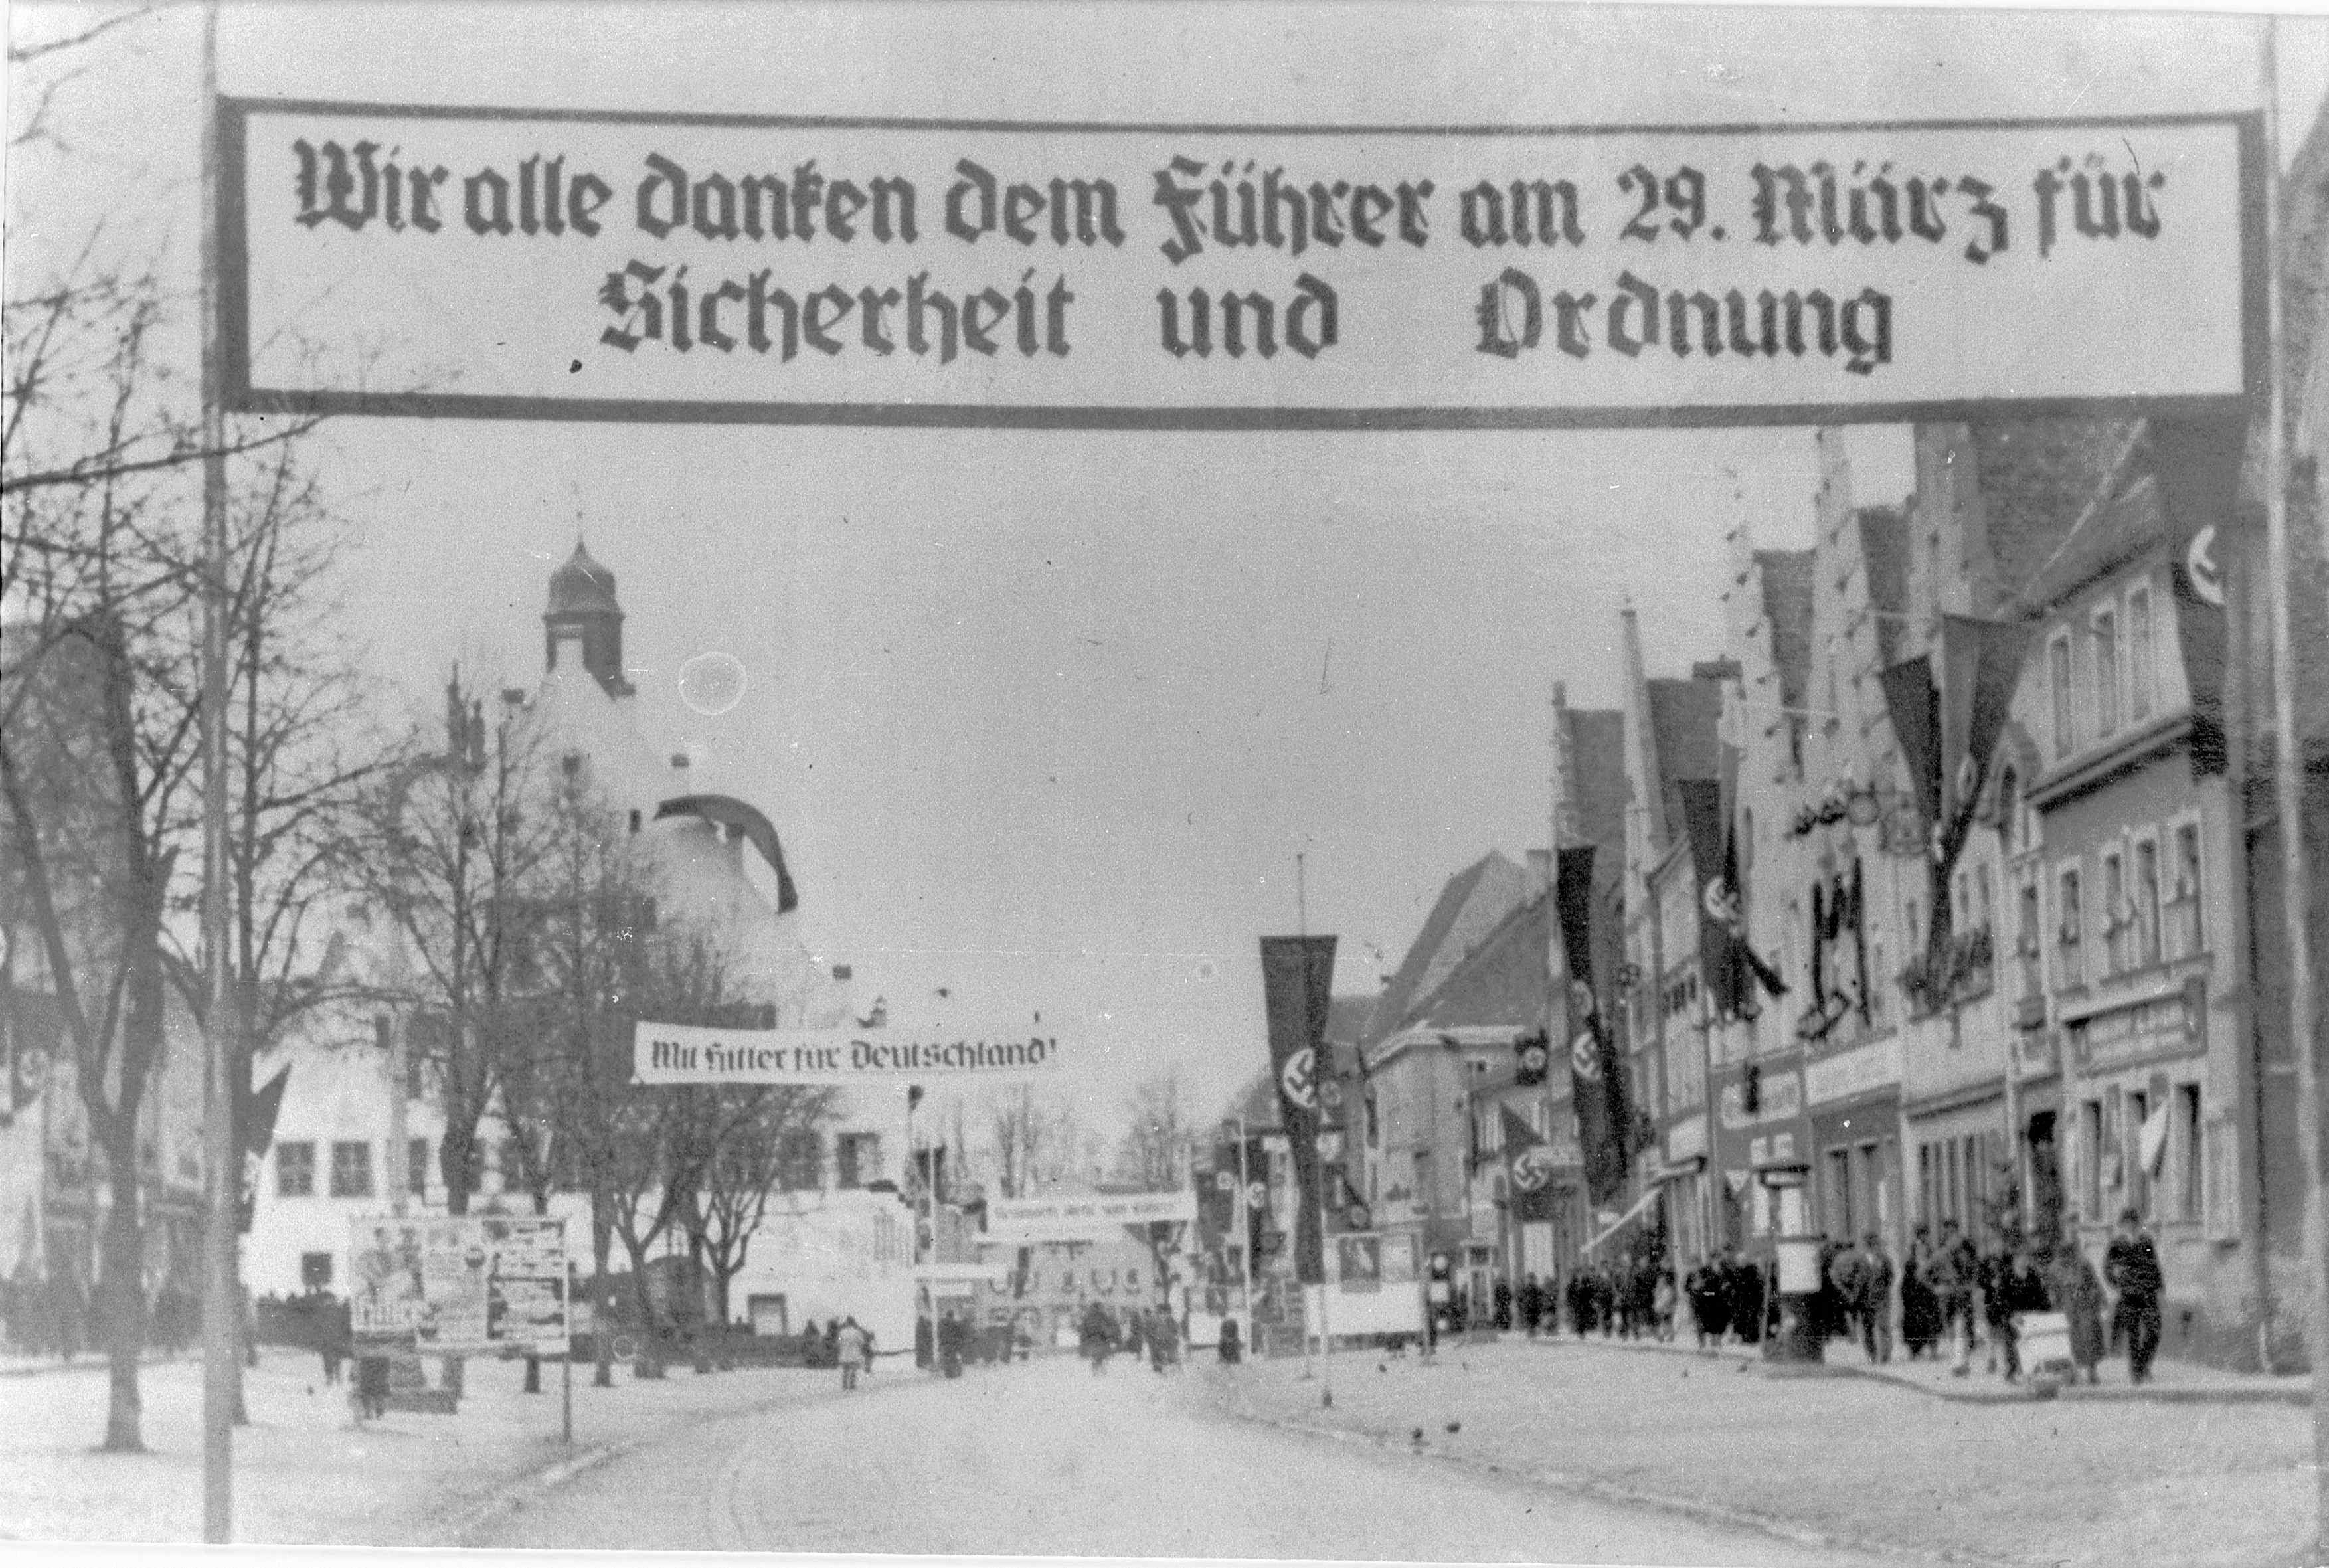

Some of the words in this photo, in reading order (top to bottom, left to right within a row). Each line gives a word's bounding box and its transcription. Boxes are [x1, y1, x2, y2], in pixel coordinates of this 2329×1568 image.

[293, 139, 448, 234] Wir
[464, 154, 613, 238] alle
[637, 153, 918, 244] danken
[945, 159, 1126, 248] dem
[1153, 155, 1434, 266] Führer
[1460, 180, 1585, 248] am
[1618, 165, 1725, 242] 29.
[1751, 162, 2008, 266] März
[2033, 154, 2165, 258] für
[599, 260, 1074, 365] Sicherheit
[1157, 273, 1338, 359] und
[1475, 267, 1892, 376] Ordnung
[652, 1041, 697, 1069] Mit
[705, 1041, 786, 1072] Hitler
